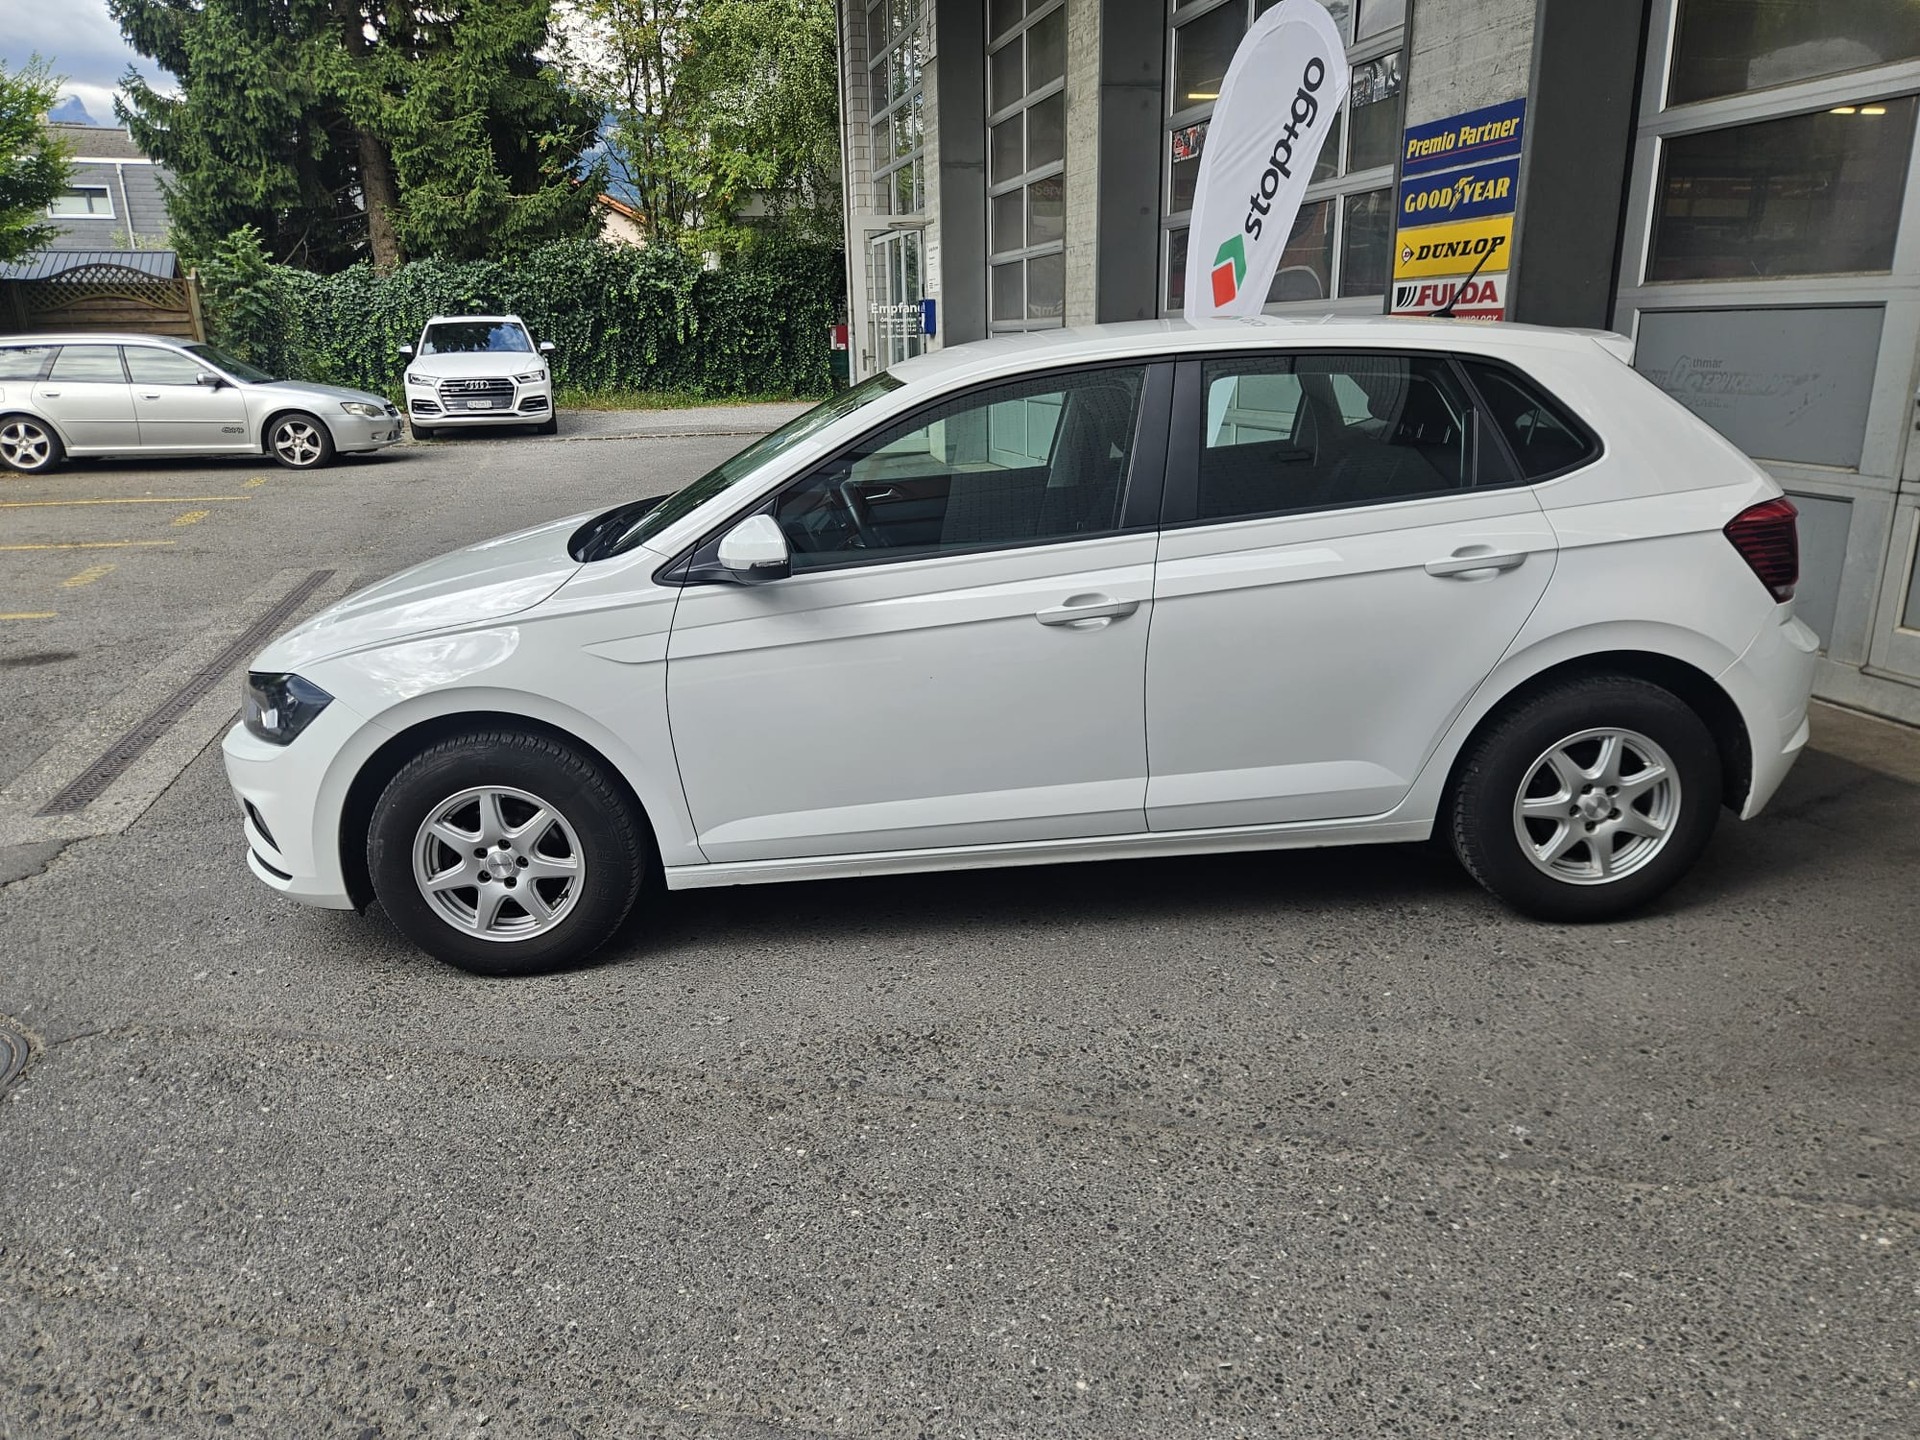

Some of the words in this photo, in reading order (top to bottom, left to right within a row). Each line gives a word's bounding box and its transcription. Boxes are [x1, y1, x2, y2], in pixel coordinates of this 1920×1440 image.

[1245, 57, 1325, 241] stop+go
[1406, 131, 1456, 159] Premio
[1458, 117, 1520, 147] Partner
[1404, 176, 1511, 213] GOODYEAR
[1416, 236, 1506, 261] DUNLOP
[1413, 280, 1499, 307] FULDA
